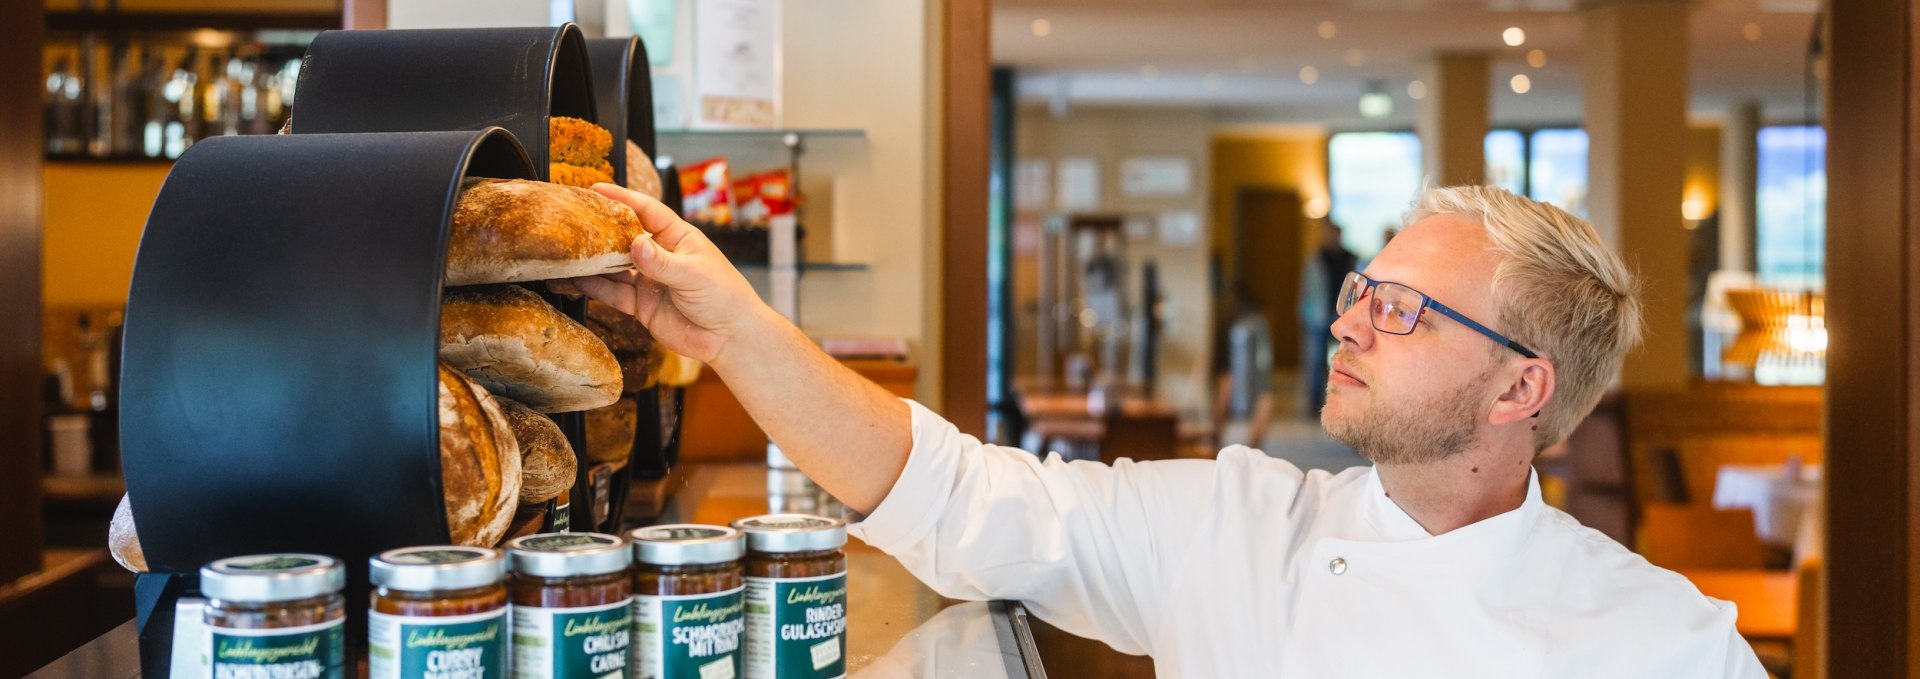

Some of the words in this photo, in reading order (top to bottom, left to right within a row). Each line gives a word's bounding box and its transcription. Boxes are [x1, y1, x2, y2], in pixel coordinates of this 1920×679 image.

[805, 603, 844, 623] RINDER-
[781, 616, 846, 641] GULASCHSUP
[426, 646, 483, 673] CURRY
[688, 638, 713, 658] MIT
[590, 650, 626, 673] CARNE
